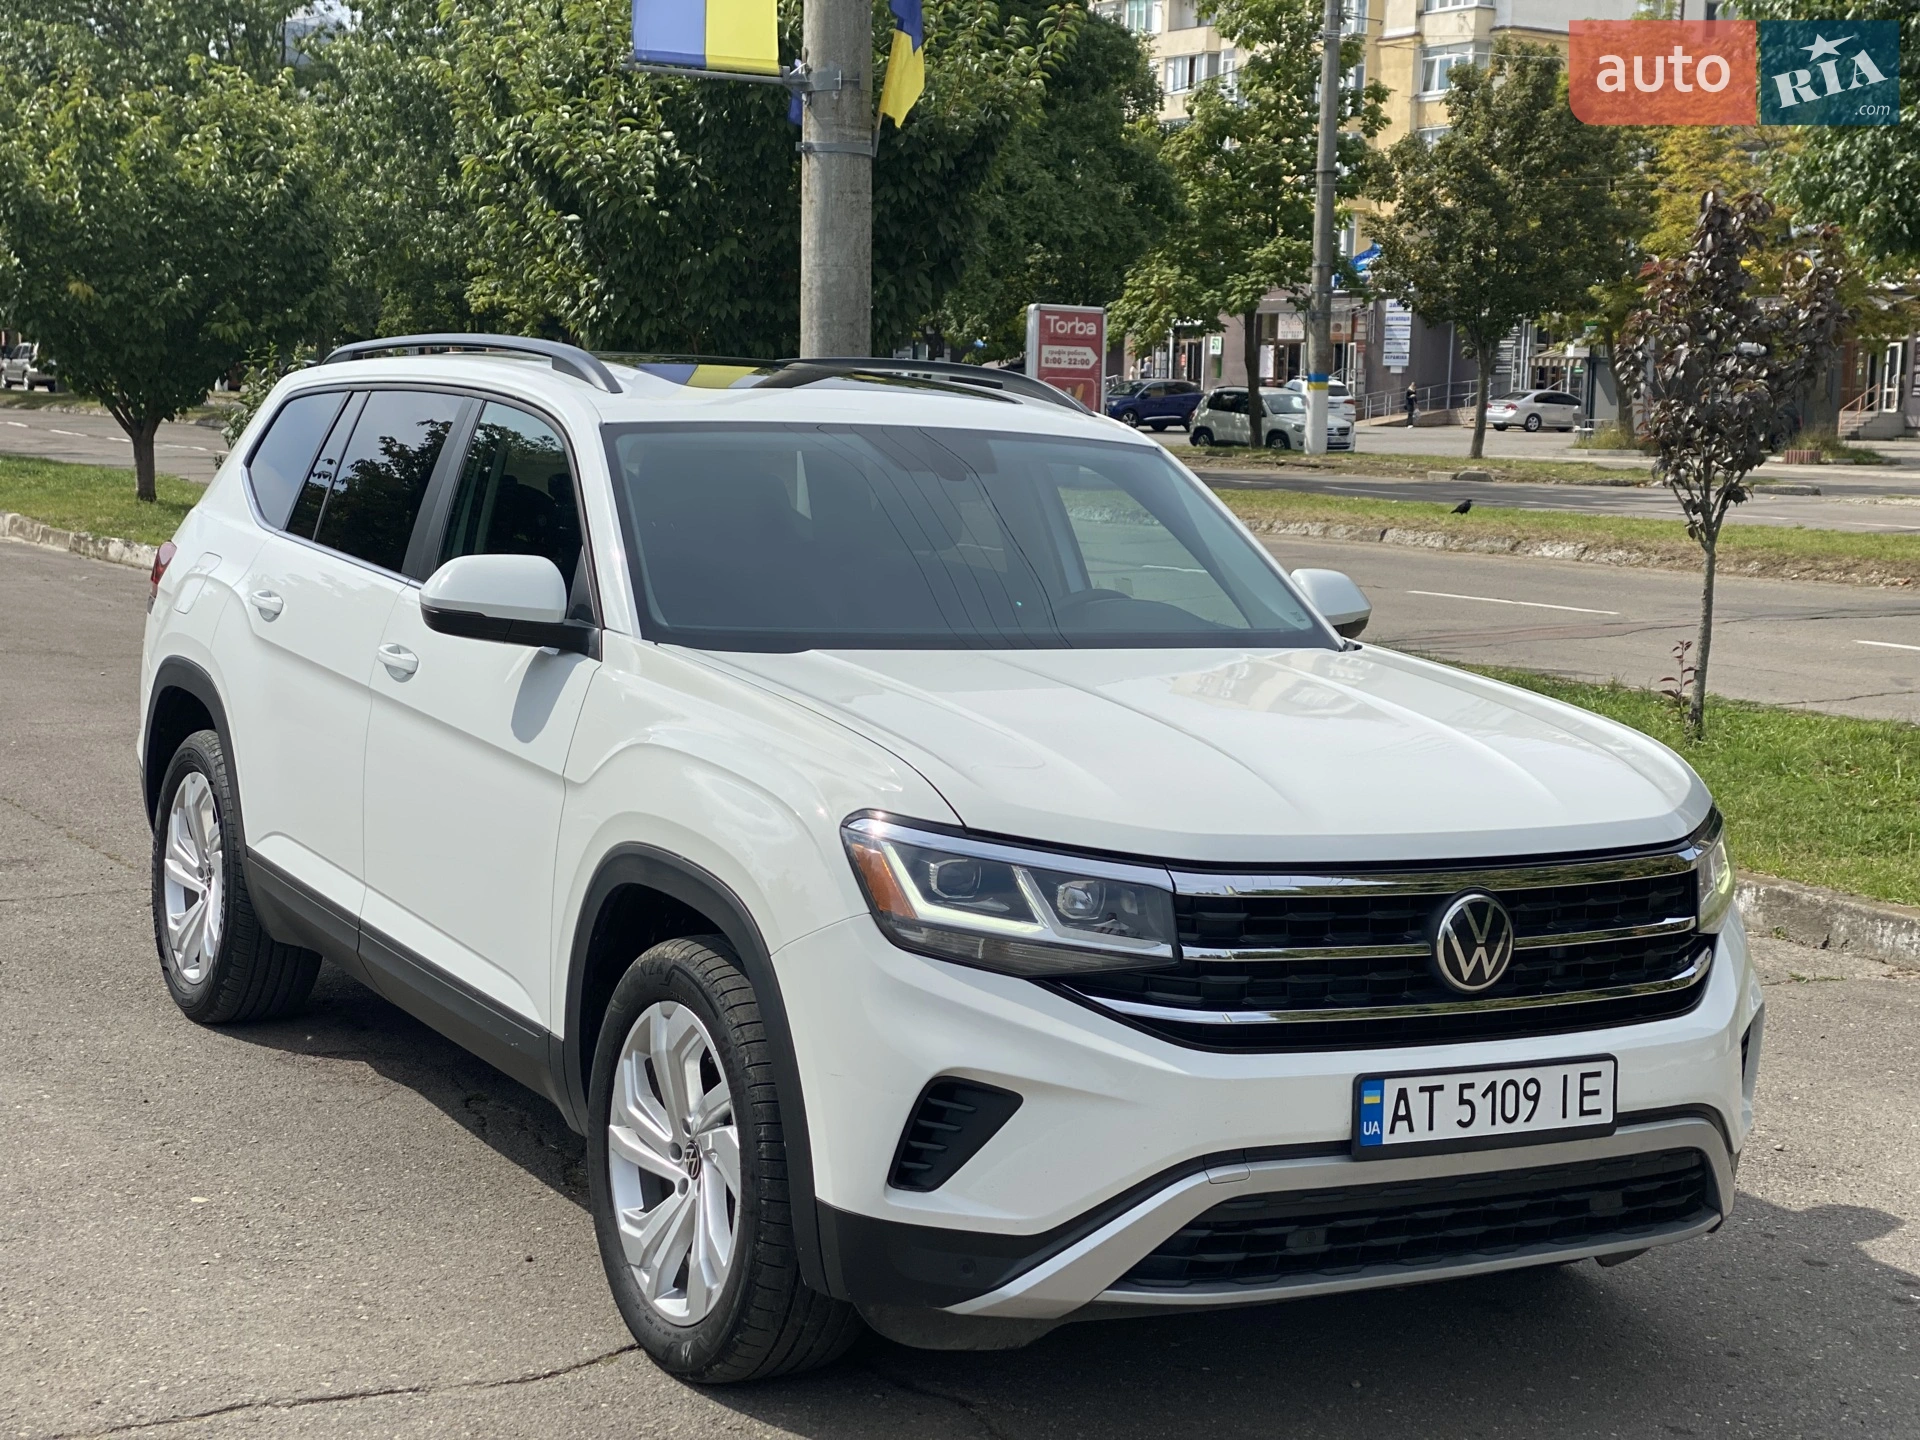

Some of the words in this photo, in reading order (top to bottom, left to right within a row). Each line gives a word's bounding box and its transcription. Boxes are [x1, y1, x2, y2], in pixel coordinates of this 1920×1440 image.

[1045, 315, 1097, 335] Torba
[1068, 357, 1090, 366] 22:00
[1389, 1083, 1445, 1135] AT
[1456, 1076, 1542, 1129] 5109
[1561, 1070, 1603, 1119] IE
[1363, 1120, 1381, 1135] UA
